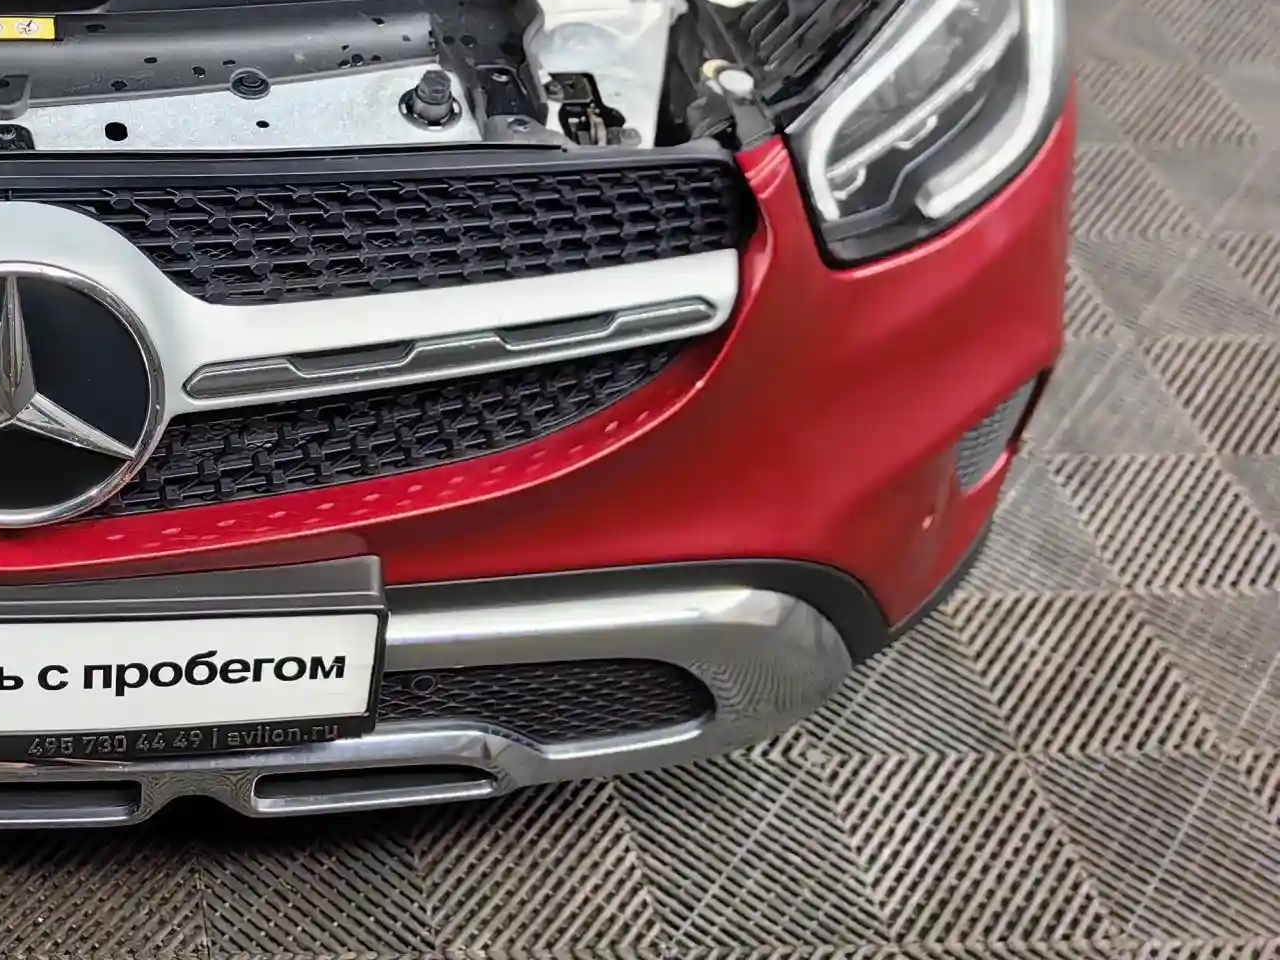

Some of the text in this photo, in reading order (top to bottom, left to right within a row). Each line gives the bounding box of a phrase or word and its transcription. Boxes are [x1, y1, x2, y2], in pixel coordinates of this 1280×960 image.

[37, 664, 69, 691] с
[83, 650, 346, 697] пробегом
[28, 735, 74, 756] 495
[81, 734, 128, 755] 730
[134, 732, 167, 752] 44
[172, 730, 201, 749] 49
